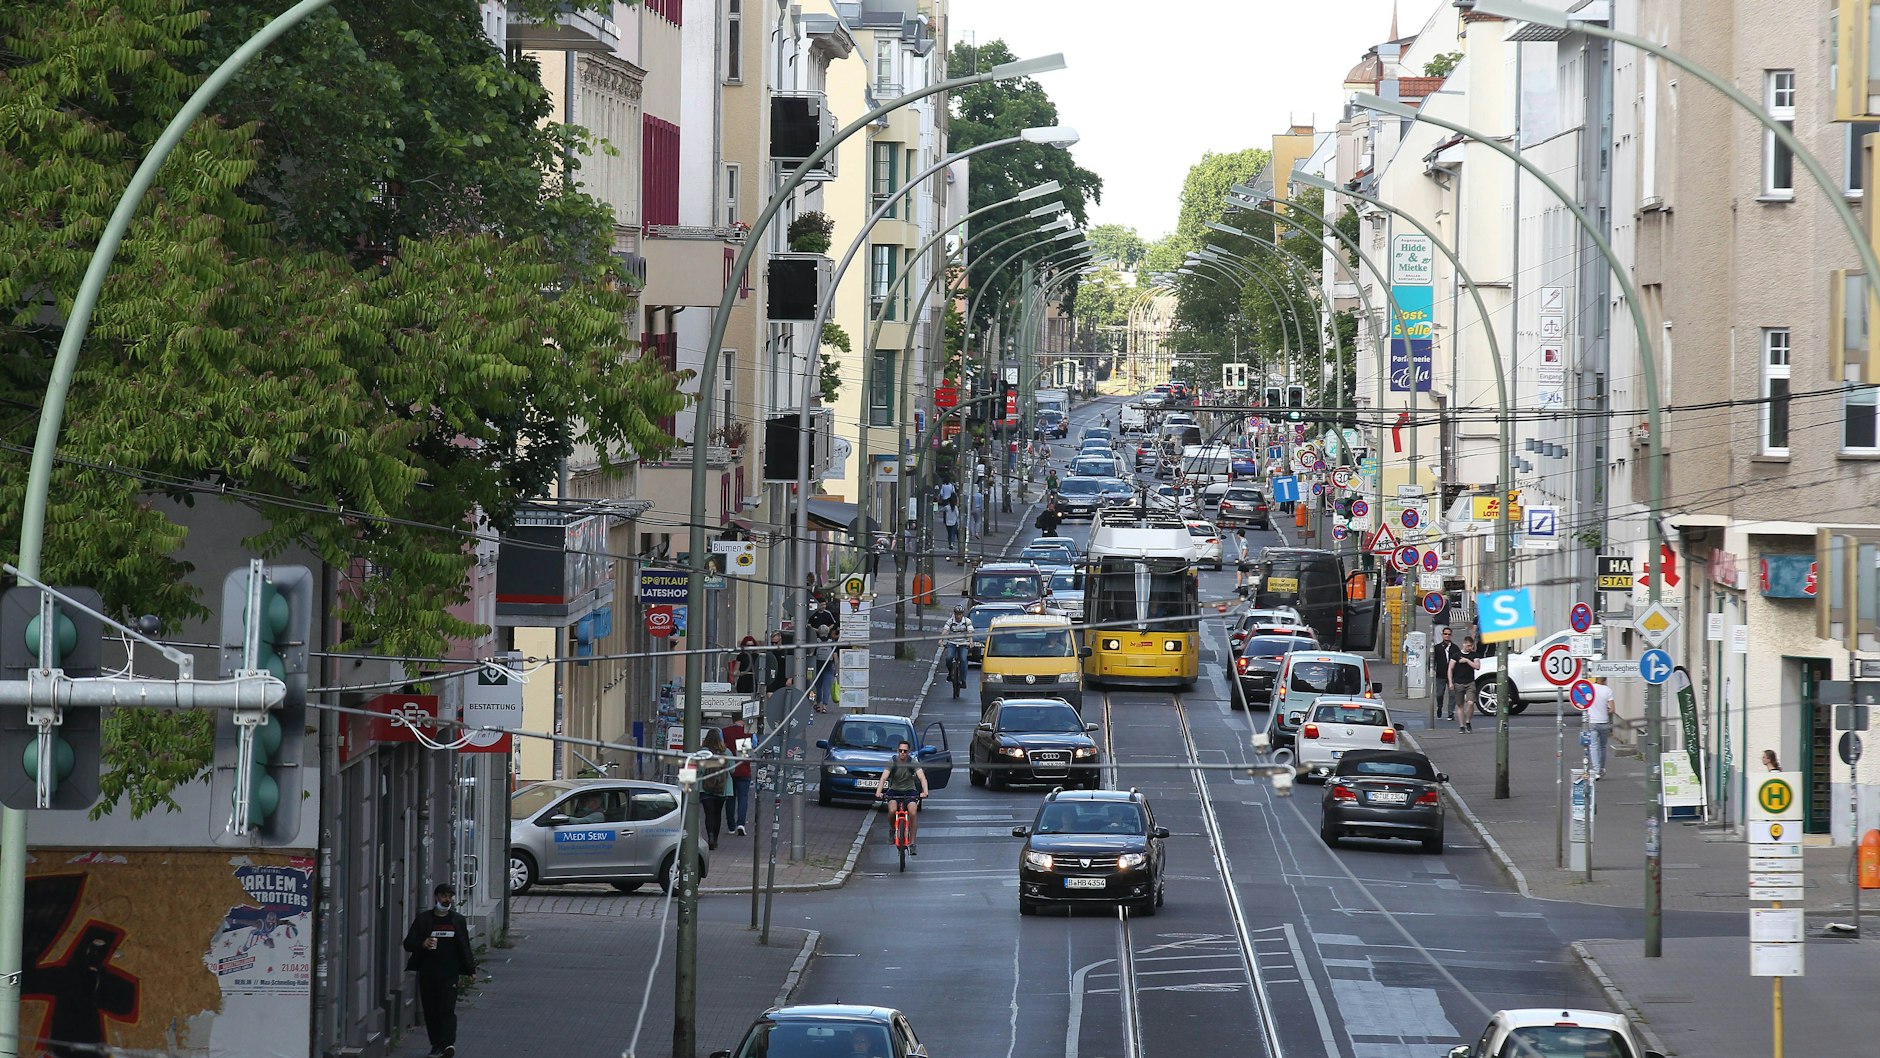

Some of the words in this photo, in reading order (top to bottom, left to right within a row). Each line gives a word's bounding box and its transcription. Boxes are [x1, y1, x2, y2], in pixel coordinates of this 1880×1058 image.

[1401, 243, 1426, 252] Hidde
[1408, 253, 1418, 262] &
[1399, 264, 1428, 272] Mietke
[1394, 324, 1431, 336] Selle
[714, 544, 742, 552] Blumen
[642, 576, 688, 586] SP@TKAUF
[642, 588, 688, 598] LATESHOP
[1493, 594, 1519, 626] S
[1549, 656, 1572, 674] 30
[1768, 787, 1784, 805] H
[588, 832, 608, 840] SERV
[282, 964, 308, 972] 21.04.20
